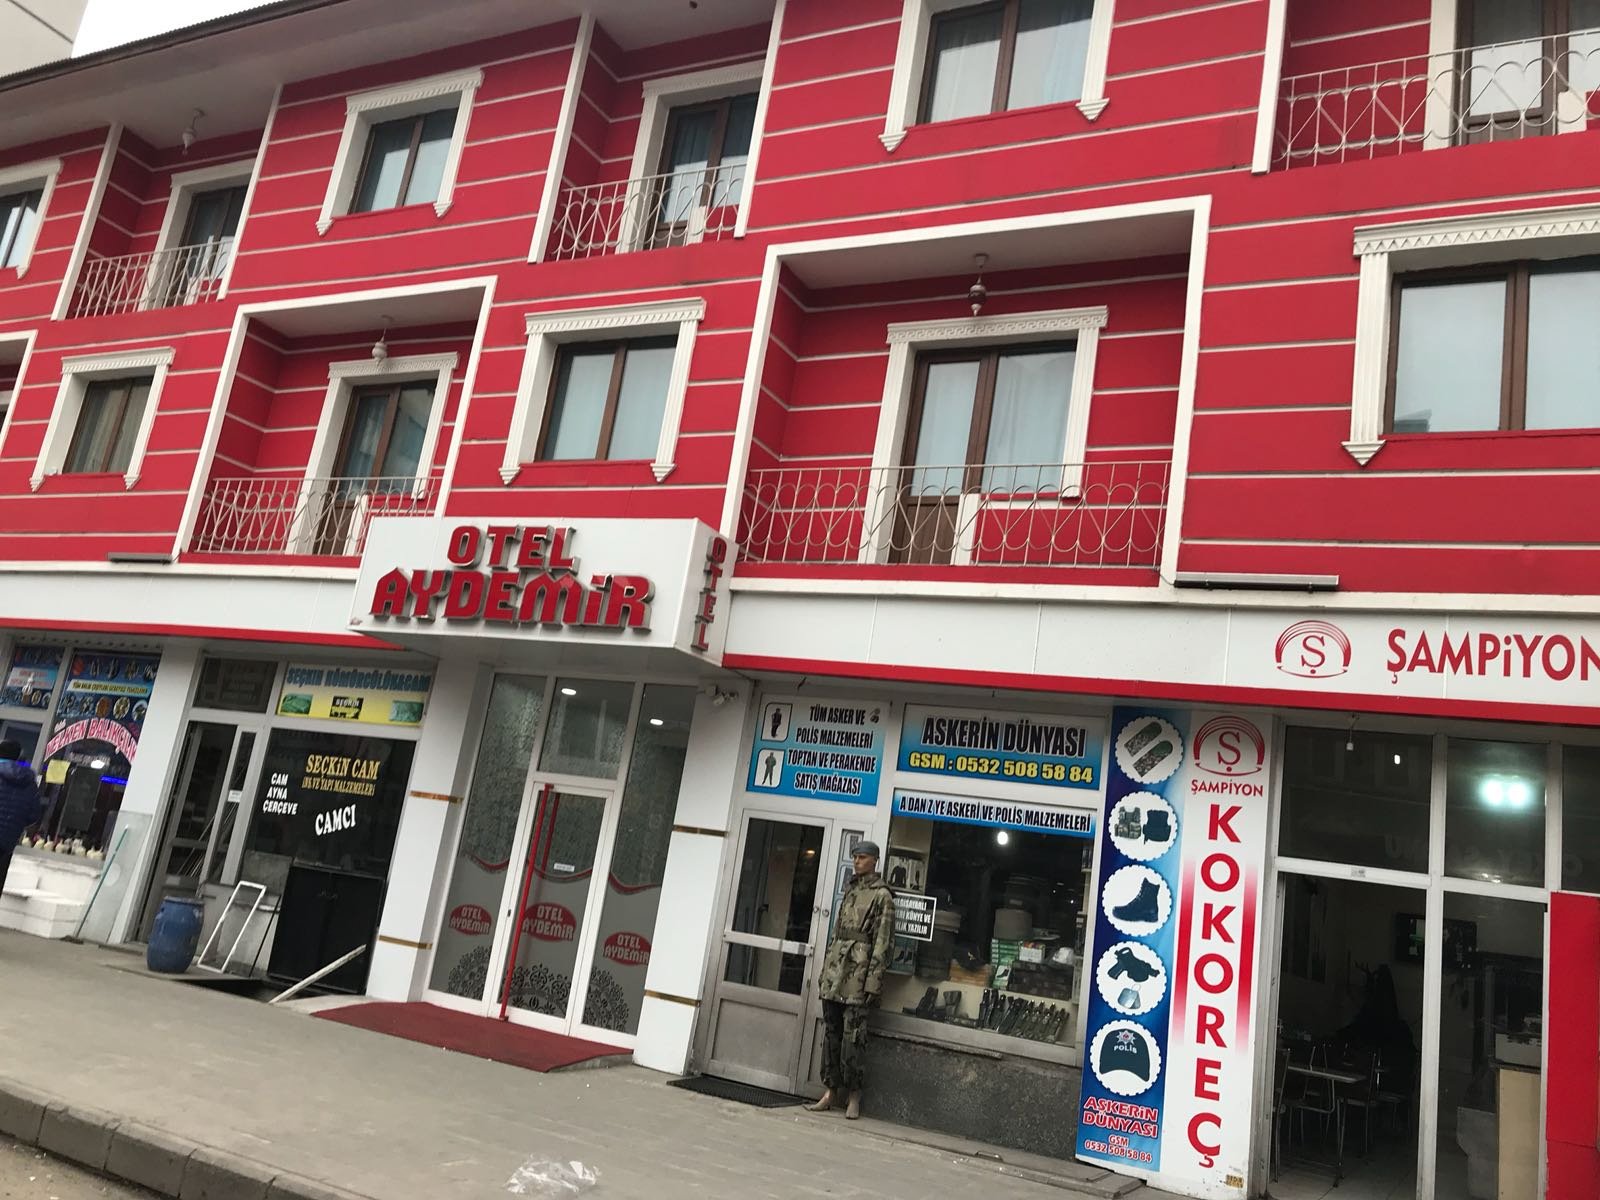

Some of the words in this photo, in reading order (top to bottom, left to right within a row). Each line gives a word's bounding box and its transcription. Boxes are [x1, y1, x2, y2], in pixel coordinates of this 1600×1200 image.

[447, 524, 580, 570] OTEL
[692, 536, 727, 651] OTEL
[810, 703, 827, 722] TÜM
[828, 708, 854, 725] ASKER
[855, 709, 866, 726] VE
[795, 726, 819, 745] POLİS
[820, 729, 874, 749] MALZEMELERİ
[922, 717, 999, 750] ASKERİN
[1003, 720, 1086, 757] DÜNYASI
[352, 758, 381, 781] CAM
[788, 749, 817, 767] TOPTAN
[818, 753, 829, 768] VE
[830, 754, 876, 773] PERAKENDE
[909, 752, 945, 770] GSM
[956, 756, 1000, 775] 0532
[1003, 759, 1038, 778] 508
[1042, 763, 1065, 782] 58
[1069, 766, 1093, 784] 84
[271, 773, 289, 786] CAM
[320, 778, 334, 792] YAPI
[795, 773, 817, 793] SATIŞ
[819, 772, 861, 795] MAĞAZASI
[1191, 779, 1264, 796] ŞAMPİYON
[266, 786, 288, 800] AYNA
[262, 800, 298, 816] ÇERÇEVE
[900, 797, 906, 811] A
[908, 798, 927, 812] DAN
[928, 799, 933, 813] Z
[935, 800, 945, 815] YE
[947, 802, 980, 819] ASKERİ
[983, 805, 993, 821] VE
[995, 806, 1022, 825] POLİS
[1024, 809, 1091, 832] MALZEMELERİ
[315, 804, 357, 837] CAMCI
[461, 906, 482, 920] OTEL
[536, 905, 564, 922] OTEL
[924, 914, 931, 924] VE
[617, 933, 641, 949] OTEL
[1187, 803, 1243, 1169] KOKOREÇ
[1082, 1111, 1158, 1139] DÜNYASI
[1084, 1140, 1106, 1154] 0532
[1108, 1145, 1126, 1158] 508
[1127, 1148, 1138, 1160] 58
[1139, 1150, 1152, 1163] 84
[1108, 1135, 1129, 1148] GSM
